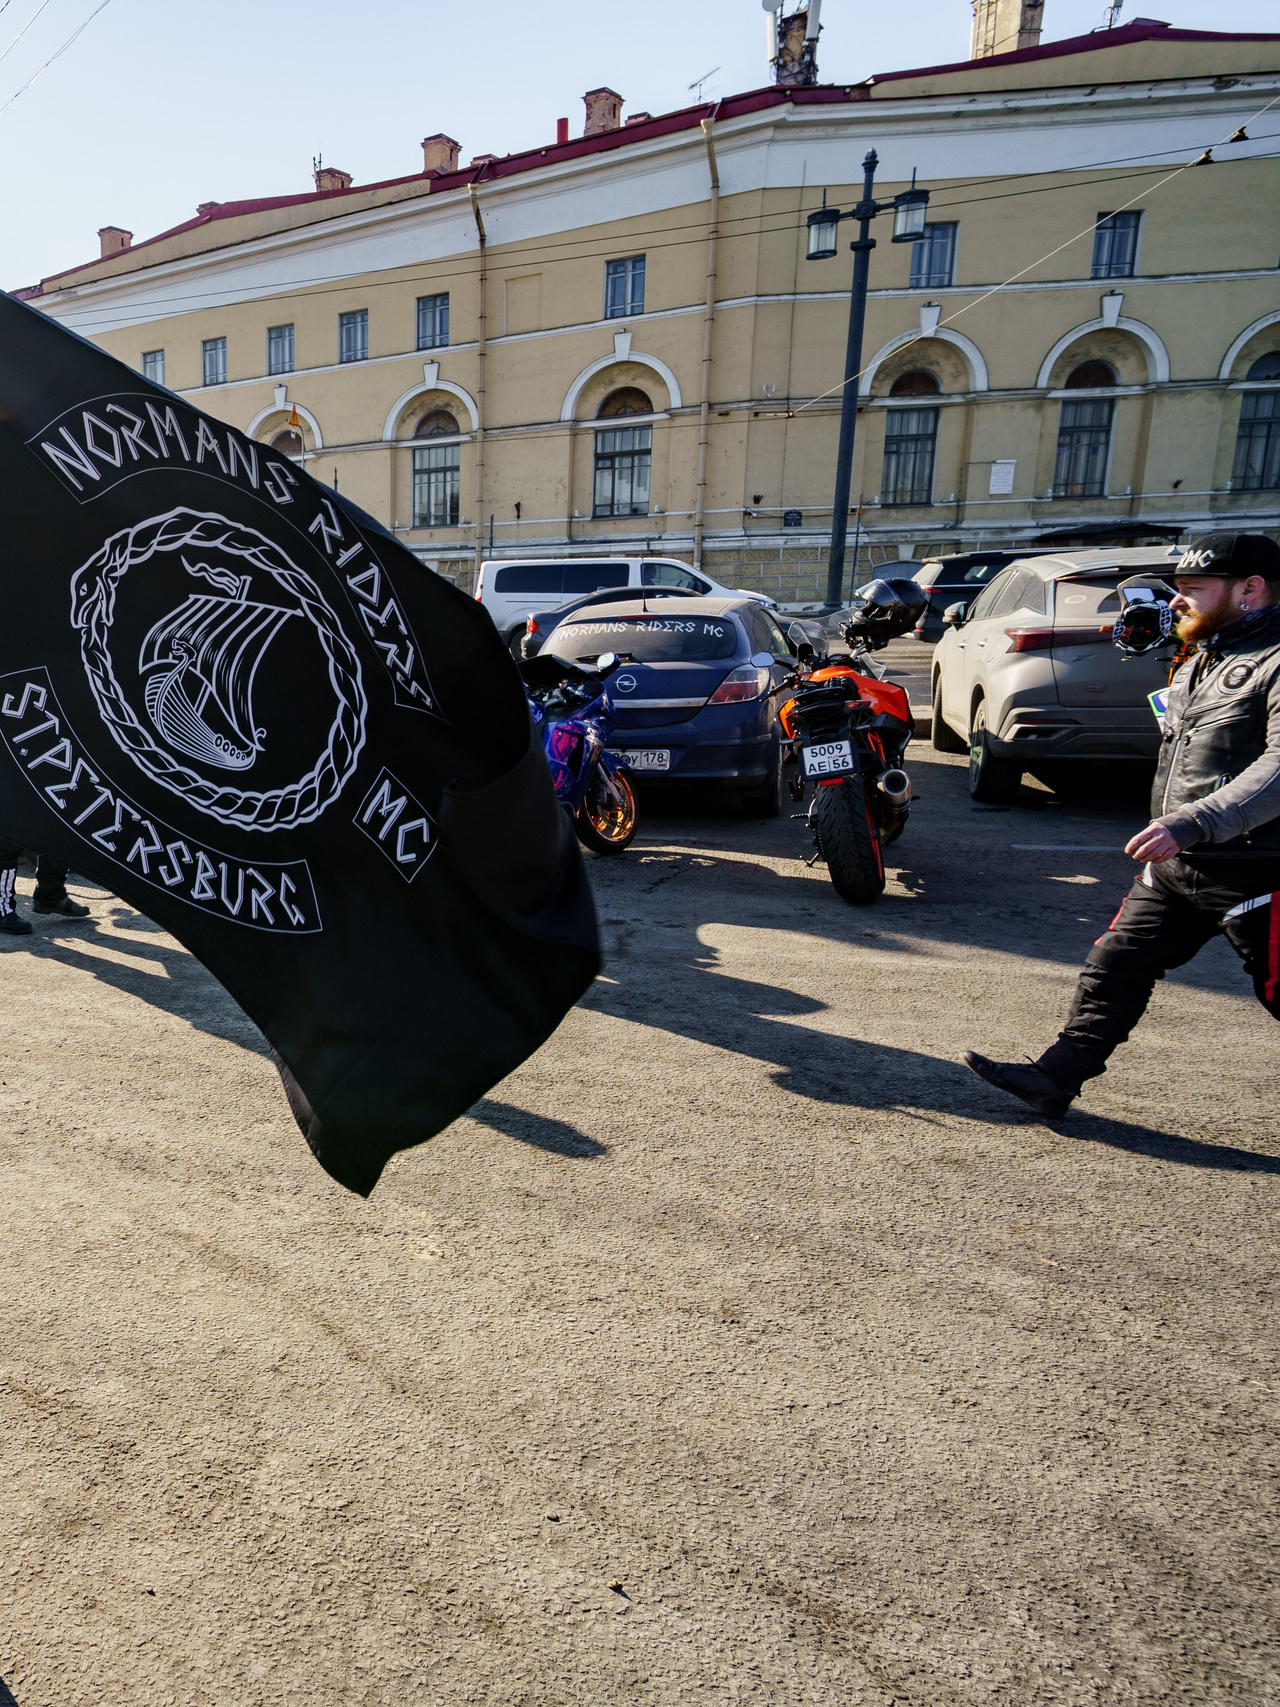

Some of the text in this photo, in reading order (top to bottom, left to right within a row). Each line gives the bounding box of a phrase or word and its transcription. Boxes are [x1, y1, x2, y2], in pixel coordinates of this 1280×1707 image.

[41, 402, 433, 709] NORMANS RIDERS
[559, 620, 724, 641] NORMANS RIDERS MC
[644, 752, 664, 763] 178
[810, 743, 843, 758] 5009
[832, 758, 850, 769] 56
[363, 779, 430, 864] MC
